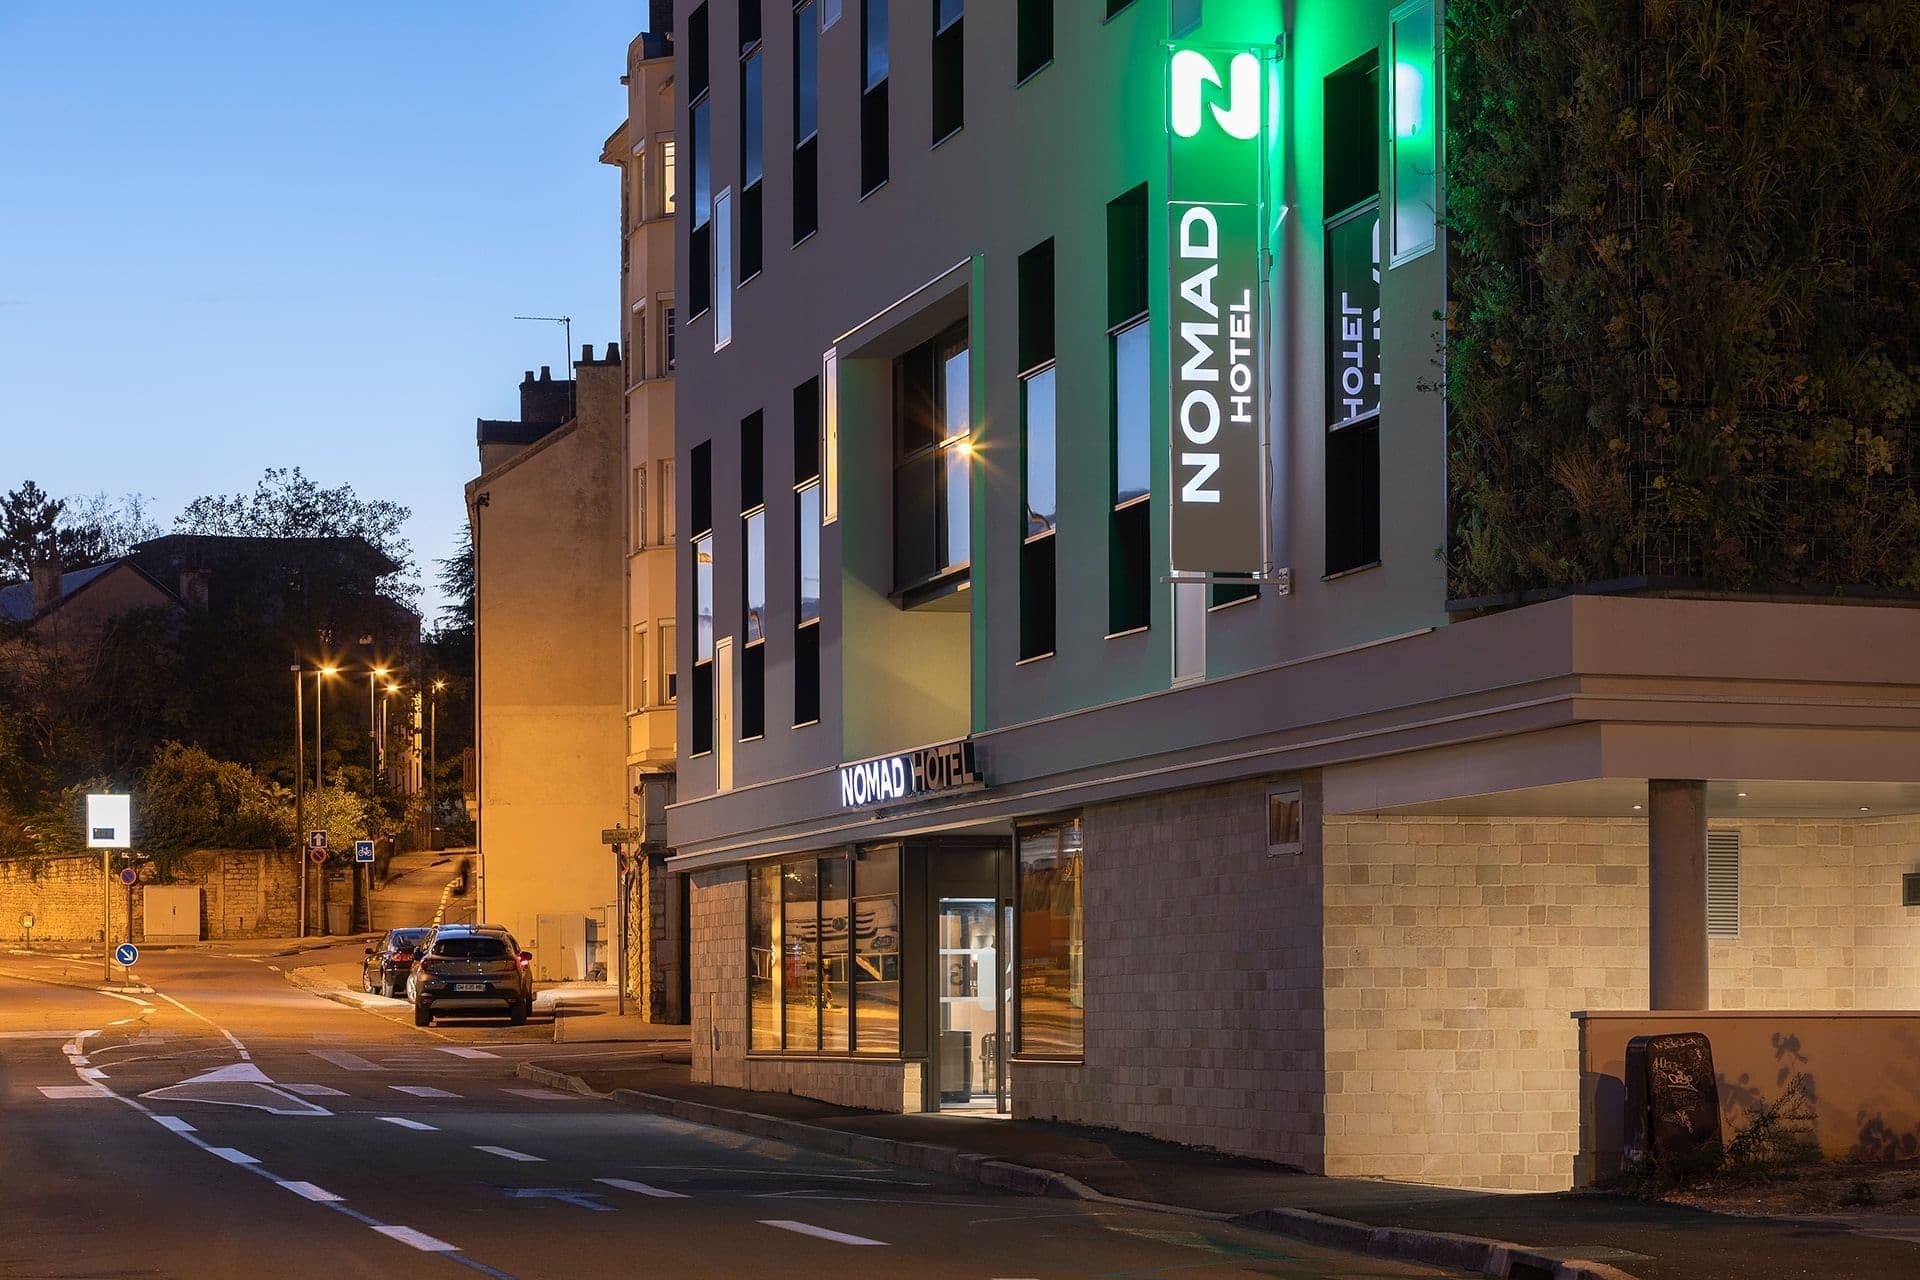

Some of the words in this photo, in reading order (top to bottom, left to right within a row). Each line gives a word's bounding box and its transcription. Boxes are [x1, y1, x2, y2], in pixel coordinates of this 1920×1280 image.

[1172, 50, 1260, 139] N
[1180, 206, 1221, 504] NOMAD
[1230, 288, 1252, 424] HOTEL
[841, 757, 905, 807] NOMAD
[913, 743, 974, 791] HOTEL
